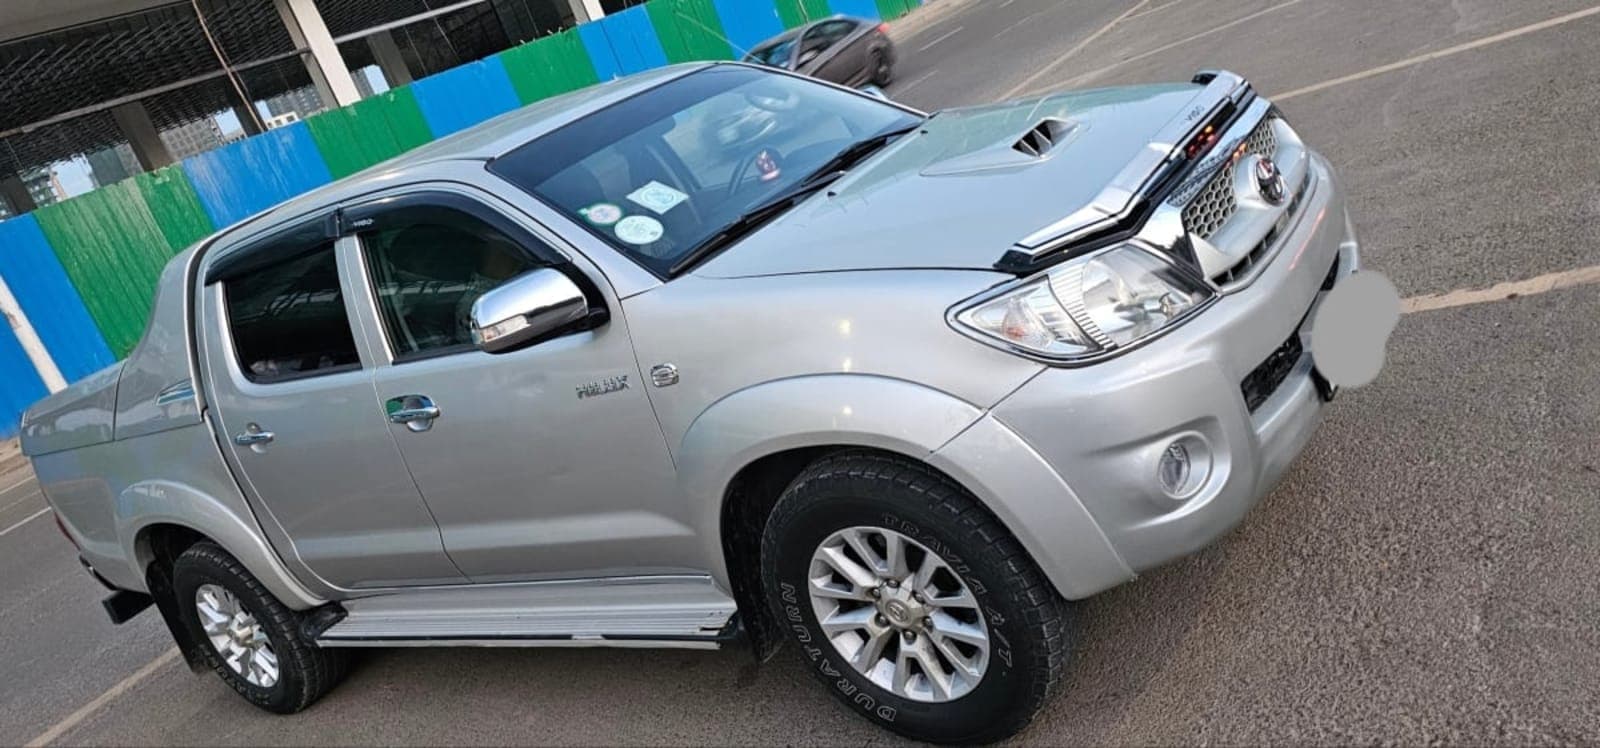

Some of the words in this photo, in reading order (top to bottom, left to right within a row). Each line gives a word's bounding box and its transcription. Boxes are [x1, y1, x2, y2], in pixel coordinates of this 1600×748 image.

[780, 581, 897, 722] DURATURN
[882, 511, 988, 596] TRAVIA
[984, 606, 1013, 668] A/T
